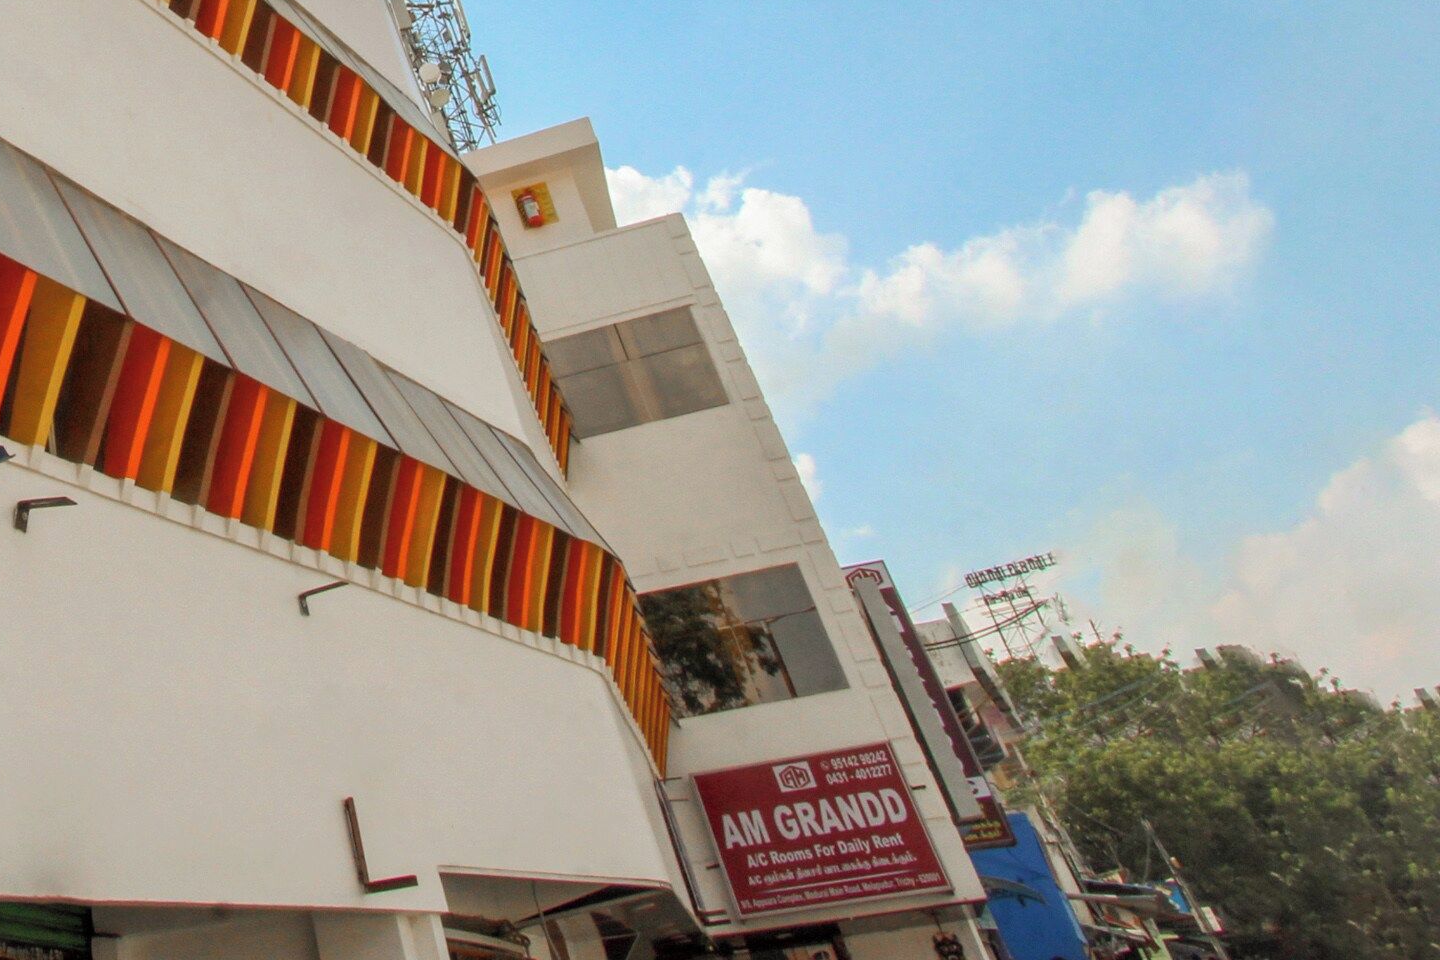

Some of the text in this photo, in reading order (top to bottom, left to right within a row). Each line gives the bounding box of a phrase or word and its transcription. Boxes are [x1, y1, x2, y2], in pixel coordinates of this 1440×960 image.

[722, 788, 907, 849] AM GRANDD
[747, 833, 905, 869] A/C Rooms For Daily Rent
